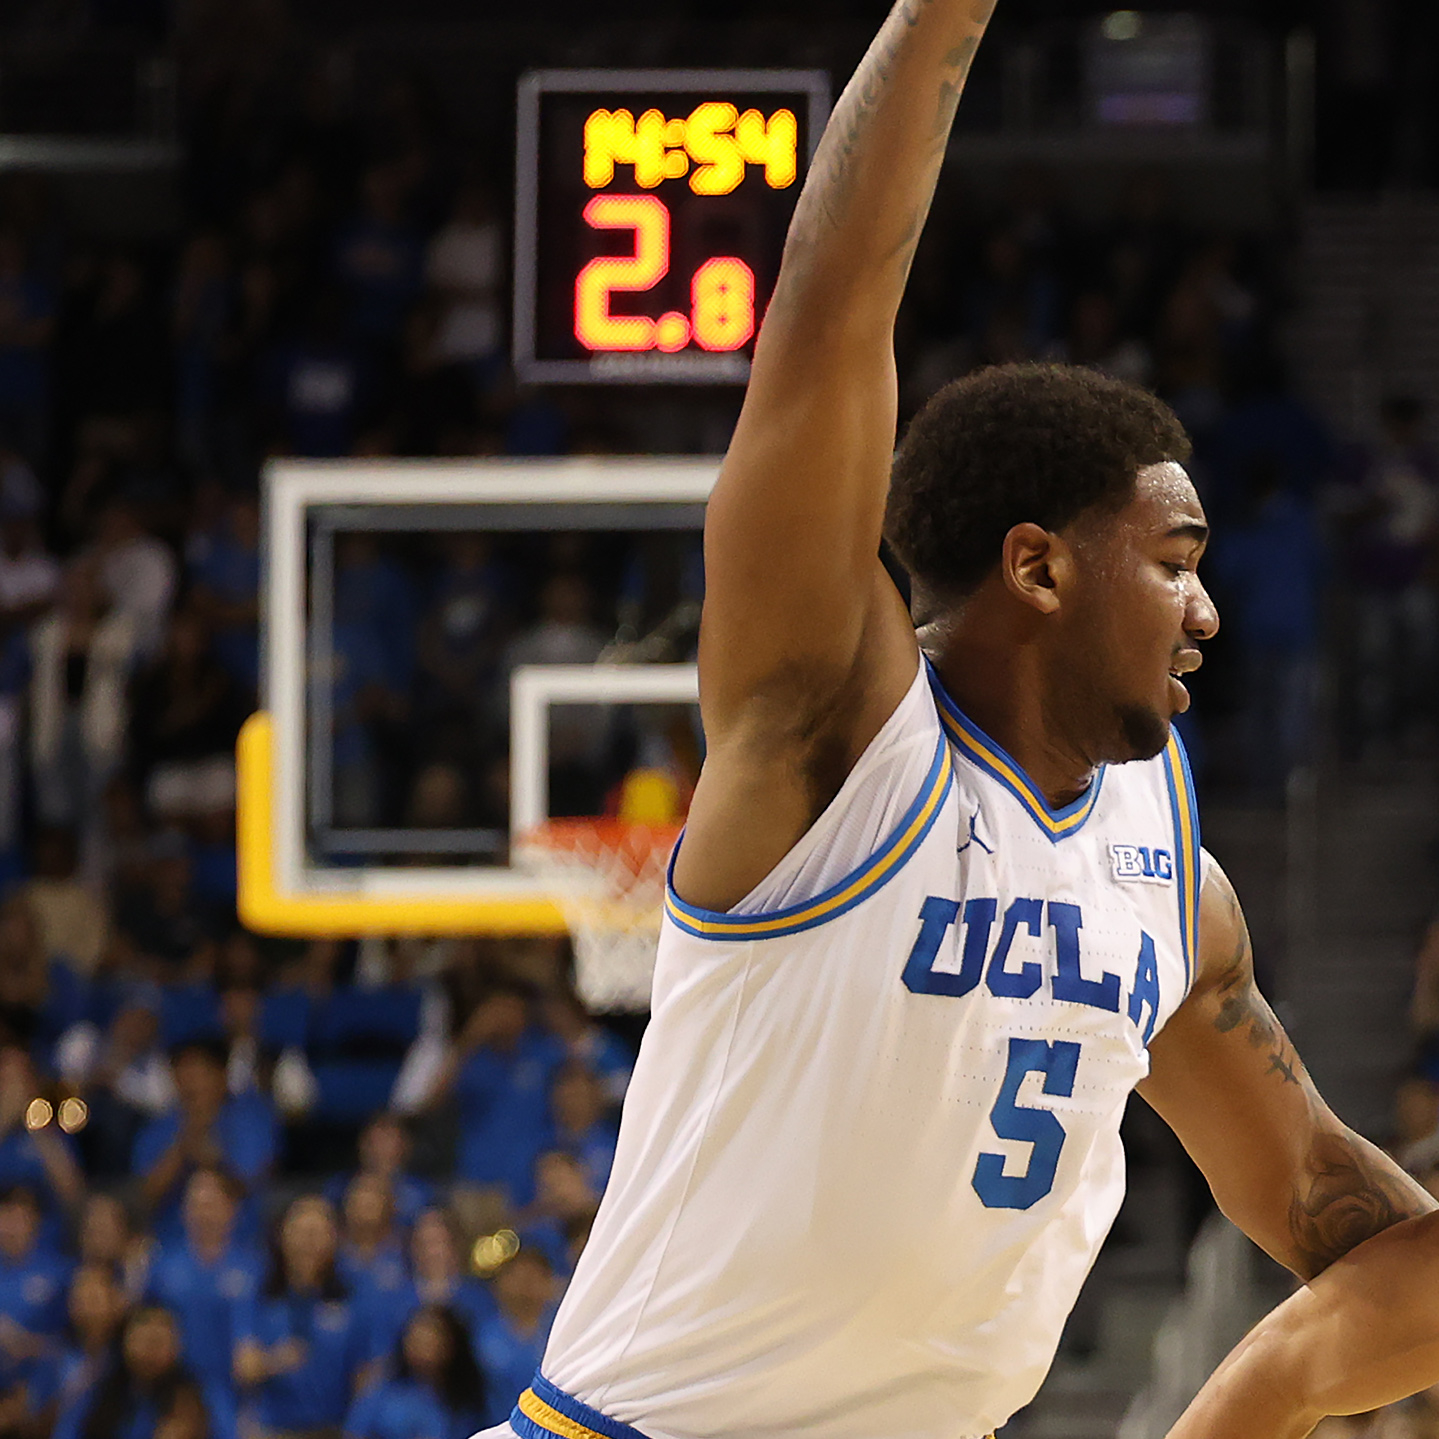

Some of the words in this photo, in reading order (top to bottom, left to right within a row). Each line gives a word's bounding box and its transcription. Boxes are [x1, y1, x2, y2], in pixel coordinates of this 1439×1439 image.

[583, 102, 798, 196] 14:54
[574, 193, 755, 352] 2.8
[901, 895, 1161, 1050] UCLA
[970, 1038, 1082, 1210] 5
